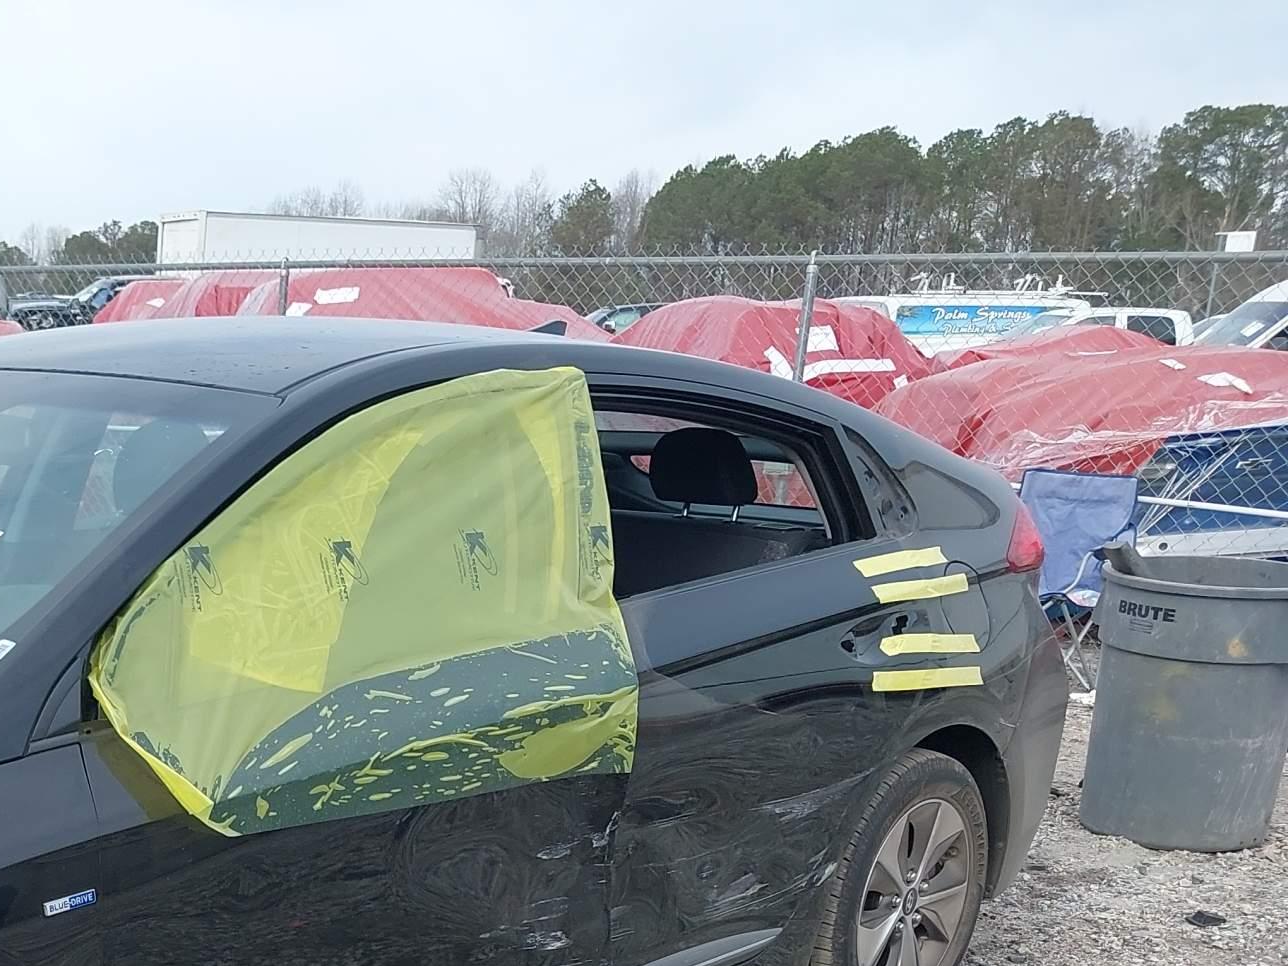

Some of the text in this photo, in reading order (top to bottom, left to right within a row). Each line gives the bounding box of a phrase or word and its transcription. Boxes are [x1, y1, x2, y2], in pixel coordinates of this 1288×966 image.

[931, 307, 1032, 324] Palm Springs
[942, 324, 986, 336] Plumbing
[988, 325, 998, 334] &
[338, 568, 349, 600] KENT
[471, 558, 481, 592] KENT
[193, 576, 202, 613] KENT
[1118, 600, 1177, 623] BRUTE
